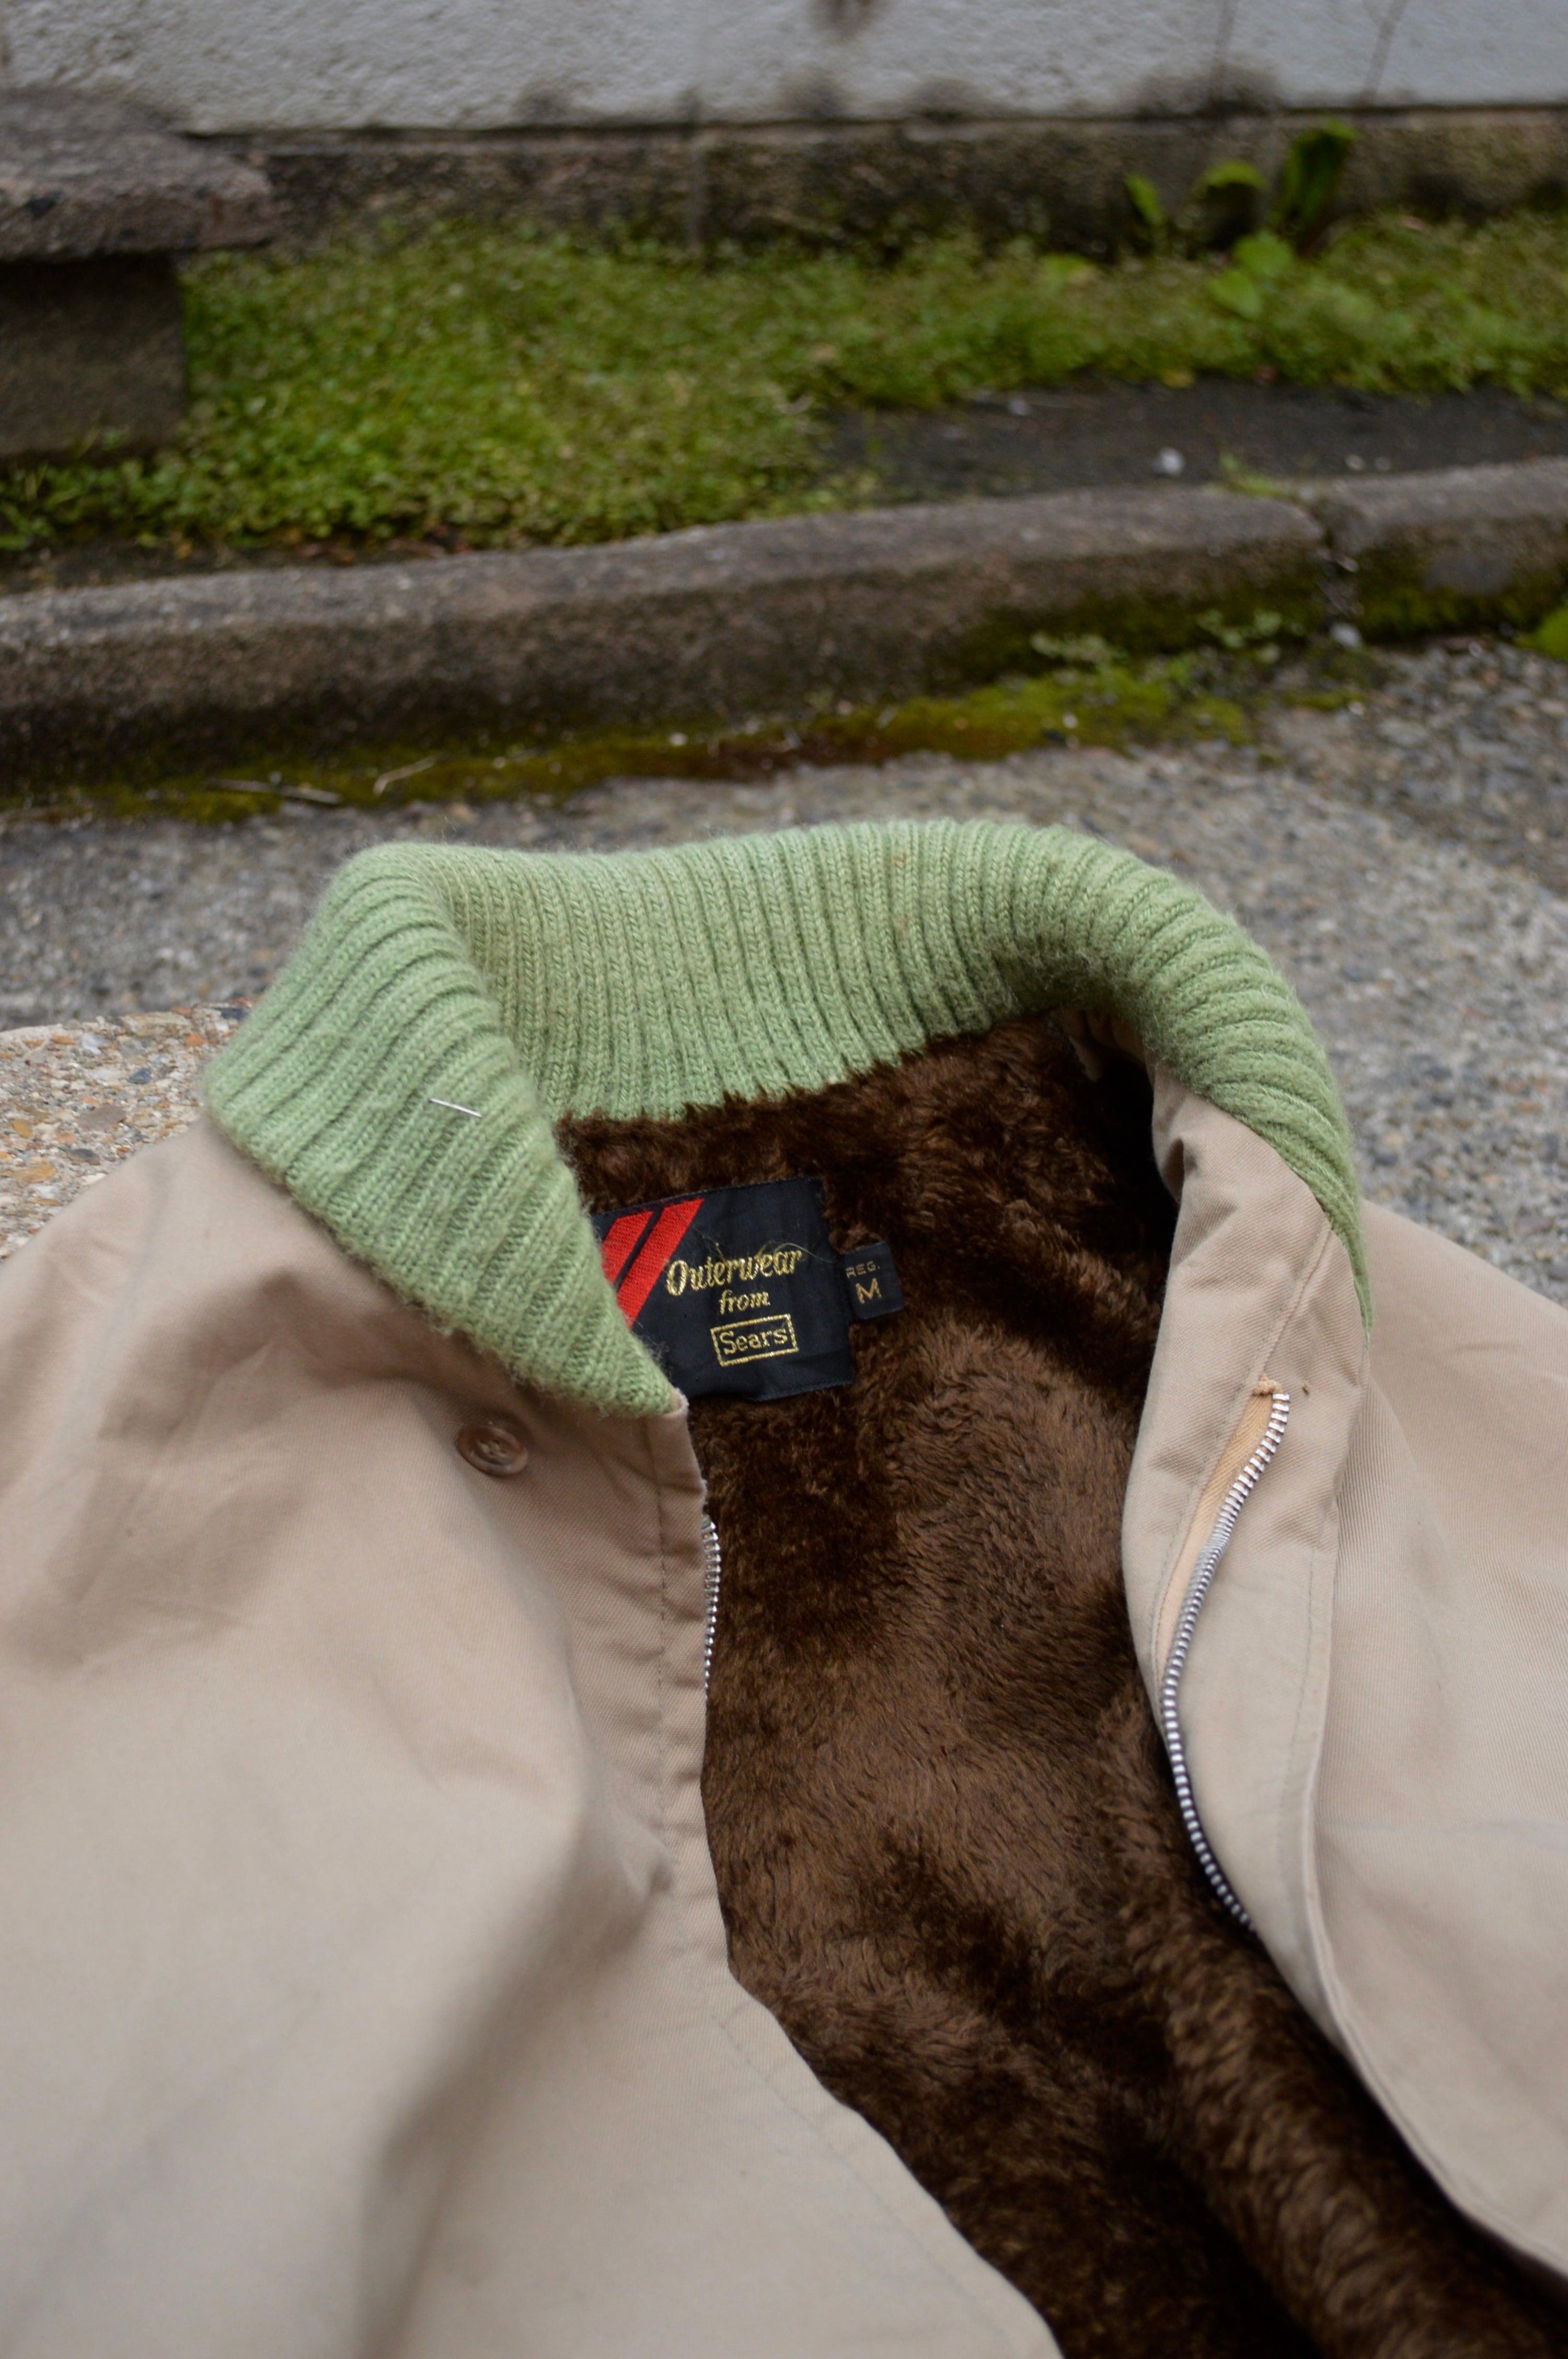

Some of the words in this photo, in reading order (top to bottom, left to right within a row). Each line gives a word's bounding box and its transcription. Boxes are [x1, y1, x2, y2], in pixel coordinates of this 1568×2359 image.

[666, 1250, 802, 1297] Outerwear
[719, 1289, 770, 1315] from
[856, 1278, 882, 1304] M
[719, 1325, 788, 1355] Sears
